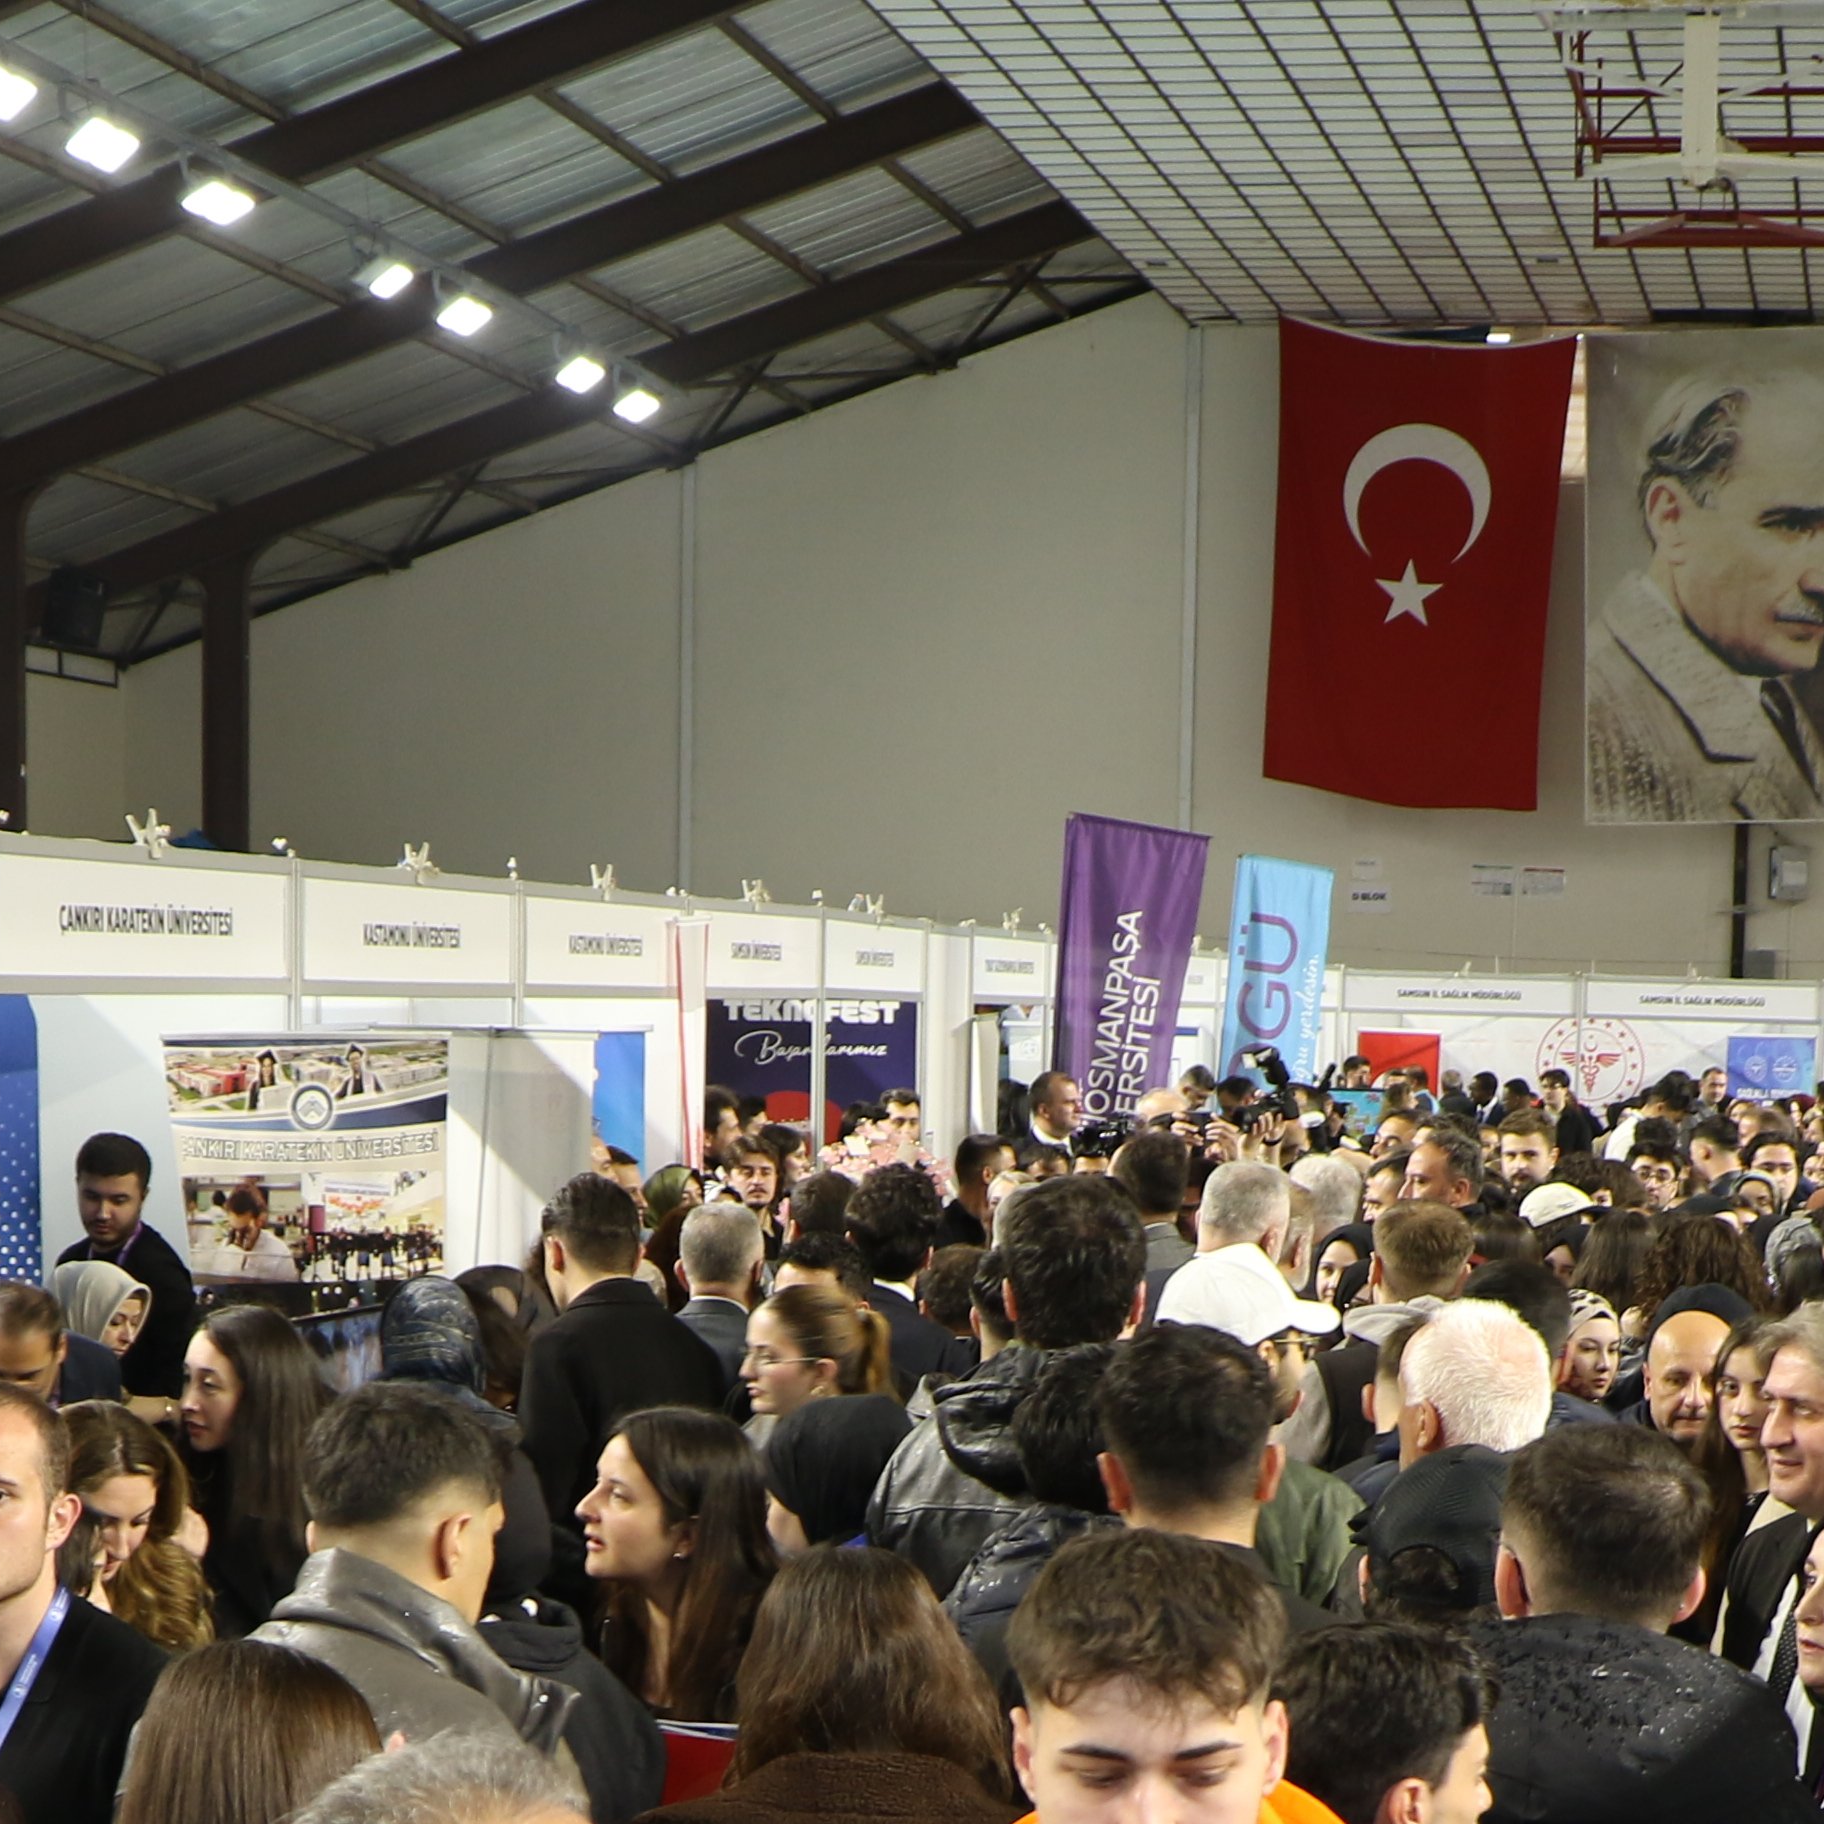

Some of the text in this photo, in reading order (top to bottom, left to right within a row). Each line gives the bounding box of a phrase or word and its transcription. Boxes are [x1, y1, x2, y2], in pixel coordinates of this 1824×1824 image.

[59, 903, 234, 936] ÇANKIRI KARATEKİN ÜNİVERSİTESİ
[1083, 910, 1144, 1123] İOSMANPAŞA
[735, 1030, 887, 1065] Başarlarımız
[1113, 976, 1161, 1117] ERSİTESİ
[243, 1137, 334, 1162] KARATEKİN
[335, 1128, 439, 1162] ÜNİVERSİTESİ
